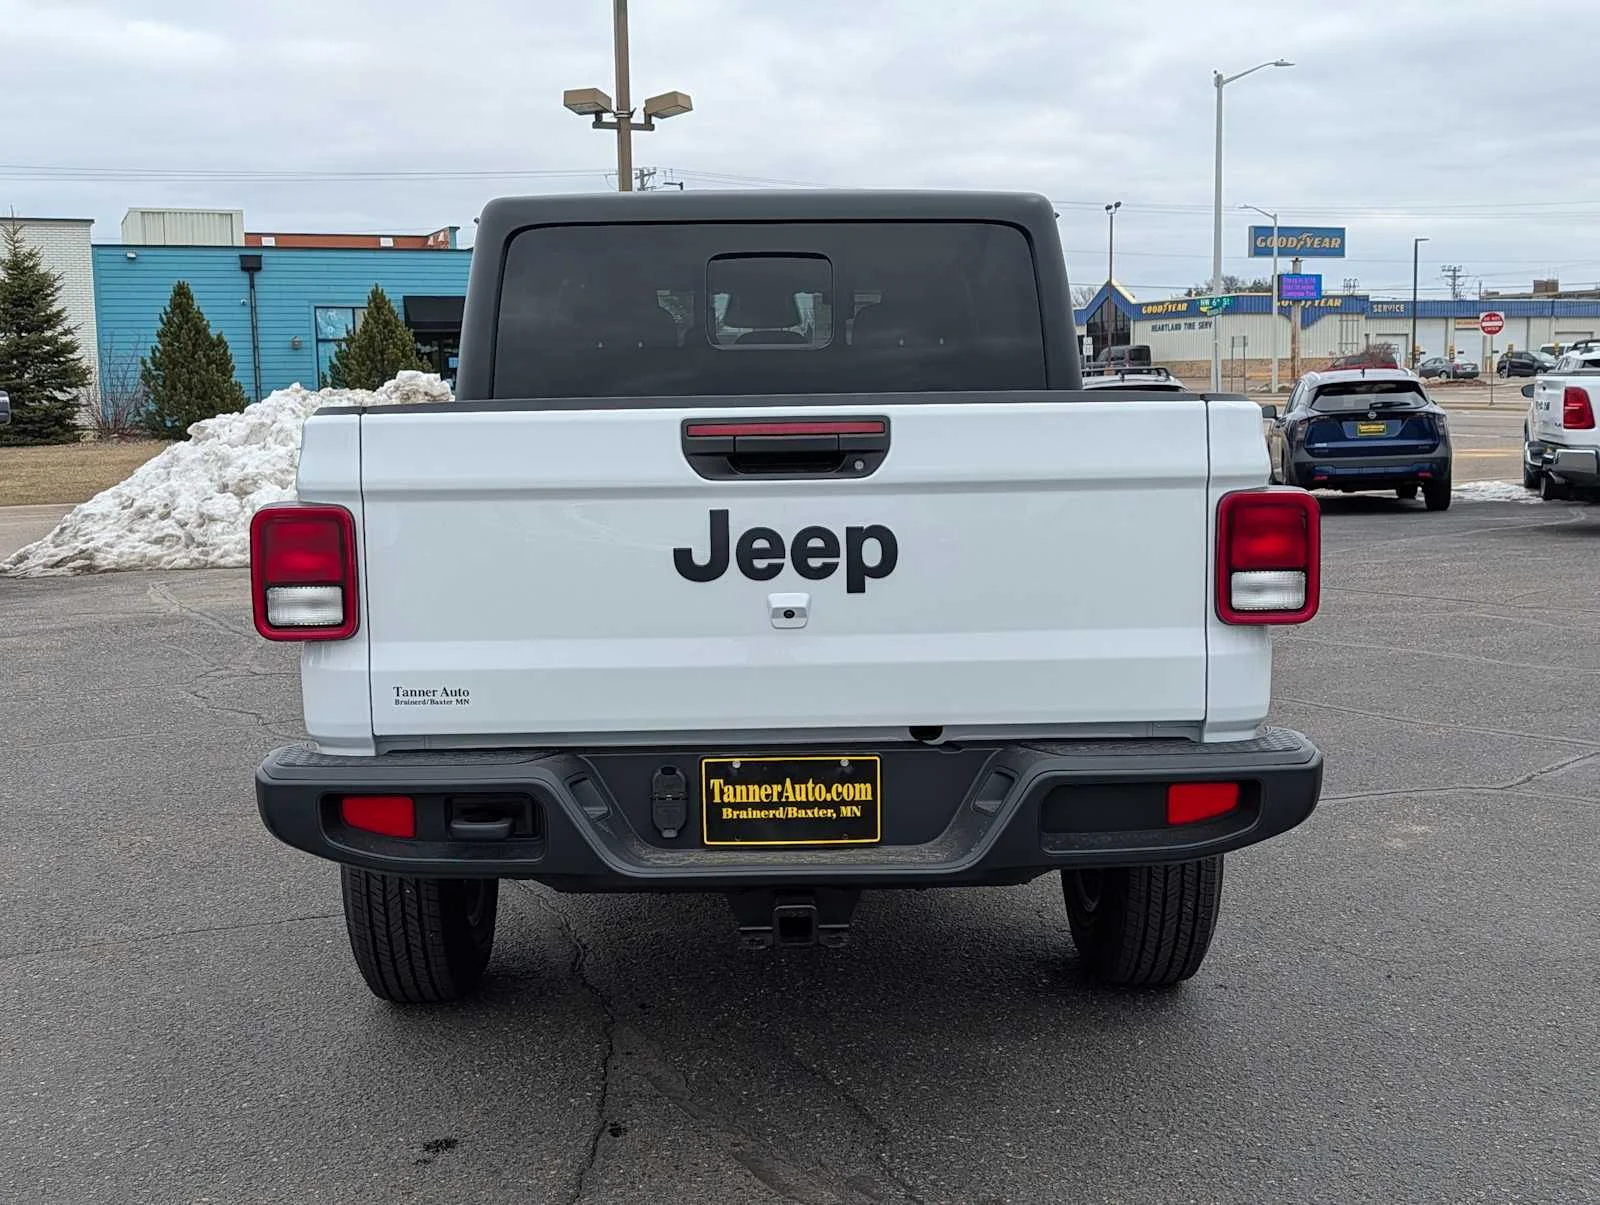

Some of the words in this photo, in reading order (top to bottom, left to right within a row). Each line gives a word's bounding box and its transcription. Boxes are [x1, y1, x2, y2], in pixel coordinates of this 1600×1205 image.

[1256, 233, 1341, 250] GOODYEAR
[1142, 303, 1188, 314] GOODYEAR
[1373, 304, 1404, 313] SERVICE
[1151, 323, 1182, 332] HEARTLAND
[1184, 322, 1195, 330] TIRE
[673, 508, 898, 593] Jeep
[393, 686, 438, 697] Tanner
[440, 687, 470, 697] Auto
[710, 777, 873, 803] TannerAuto.com
[722, 806, 837, 820] Brainerd/Baxter,
[840, 805, 862, 818] MN
